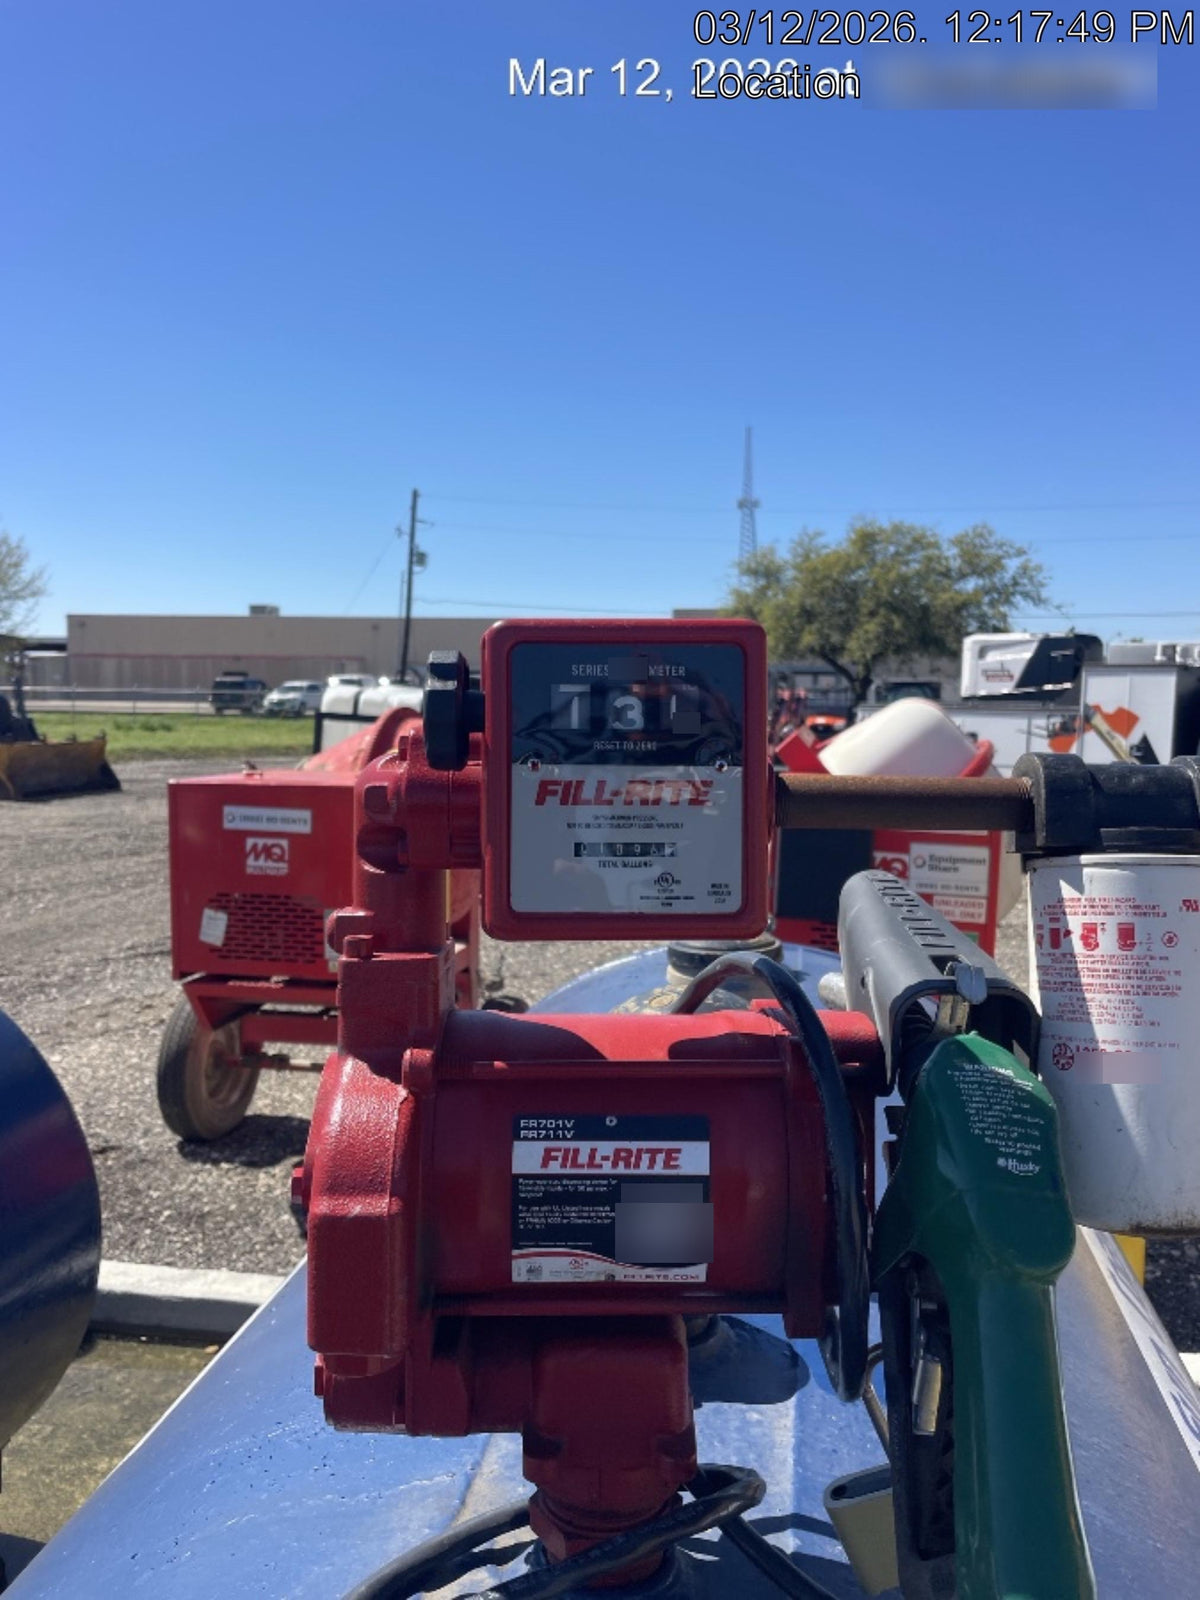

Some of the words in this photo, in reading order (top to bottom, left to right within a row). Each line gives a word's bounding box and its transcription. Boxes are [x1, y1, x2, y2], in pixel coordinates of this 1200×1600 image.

[571, 664, 608, 677] SERIES
[534, 780, 714, 806] FILL-RITE
[246, 843, 288, 862] MQ
[519, 1119, 574, 1128] FR701V
[540, 1148, 682, 1170] FILL-RITE
[1007, 1158, 1040, 1174] Husky
